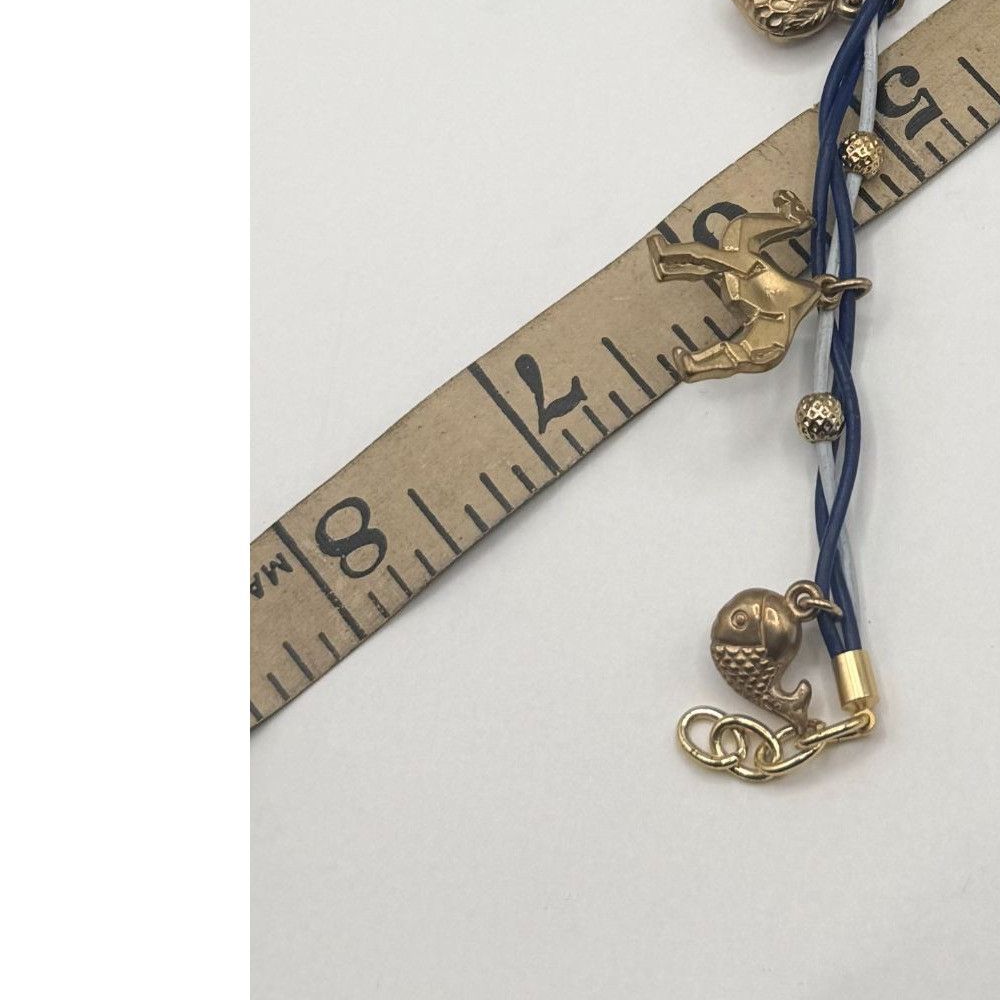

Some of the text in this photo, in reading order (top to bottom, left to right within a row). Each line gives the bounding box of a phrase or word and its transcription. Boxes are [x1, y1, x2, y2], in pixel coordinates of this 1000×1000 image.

[875, 65, 943, 141] 5
[515, 354, 587, 434] 7
[315, 496, 388, 579] 8
